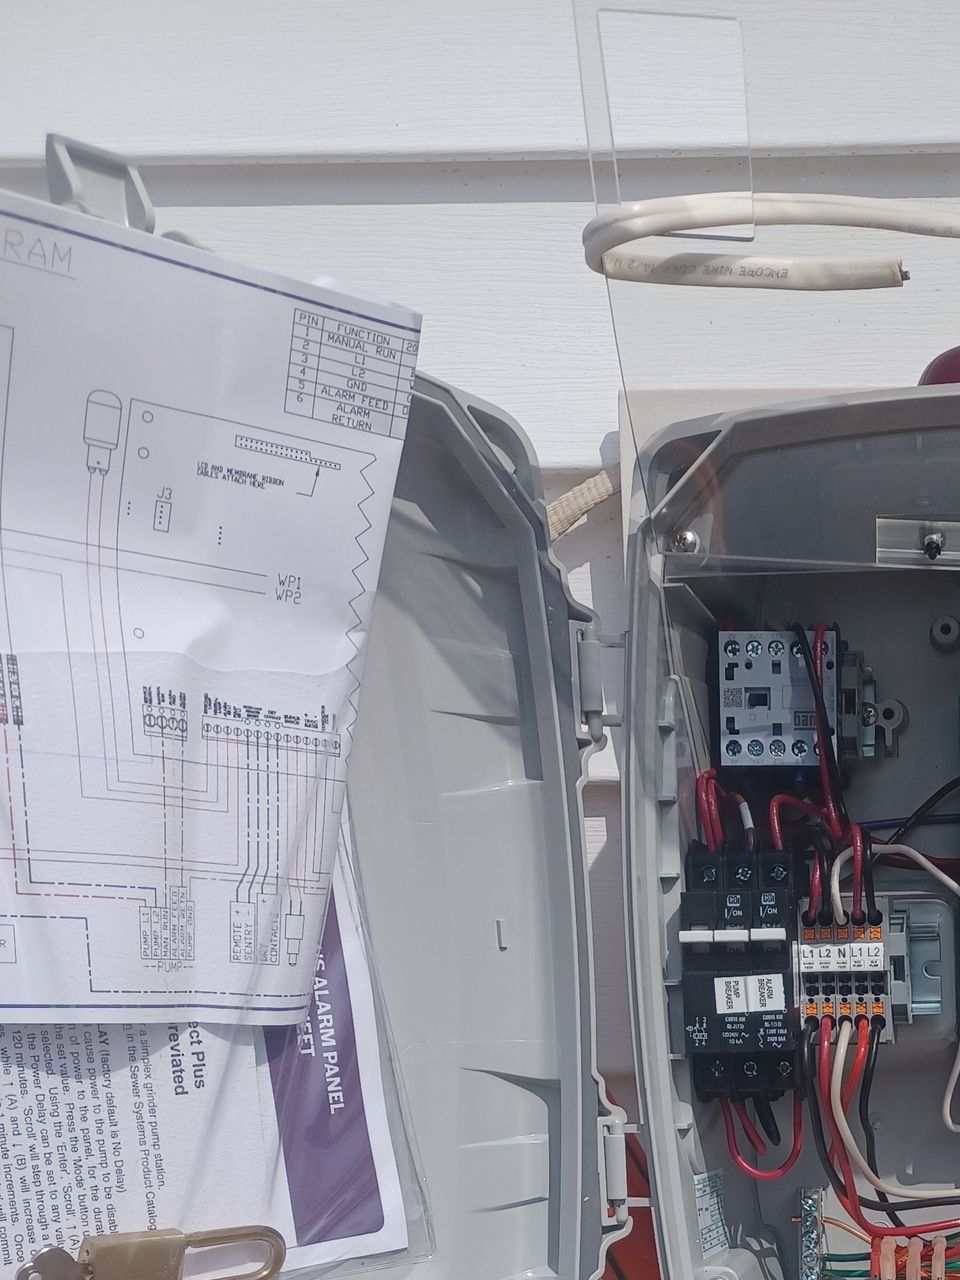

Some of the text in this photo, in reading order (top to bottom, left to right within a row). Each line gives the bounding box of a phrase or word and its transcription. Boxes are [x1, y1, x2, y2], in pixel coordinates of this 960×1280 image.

[299, 312, 391, 346] PIN FUNCTION
[302, 340, 366, 366] 2 L1
[327, 333, 368, 353] MANUAL
[375, 347, 397, 360] RUN
[300, 367, 368, 392] 4 GND
[301, 353, 366, 379] 3 L2
[296, 393, 370, 419] 6 ALARM
[298, 380, 305, 390] 5
[321, 386, 355, 402] ALARM
[361, 395, 389, 411] FEED
[331, 413, 372, 431] RETURN
[156, 487, 173, 500] J3
[222, 474, 247, 486] ATTACH
[275, 587, 302, 605] WP2
[277, 572, 302, 591] WP1
[153, 910, 160, 924] L2
[142, 912, 150, 957] PUMP L1
[233, 922, 242, 960] REMOTE
[244, 923, 253, 961] SENTRY
[803, 946, 880, 958] L1 L2 N L1 L2
[157, 961, 183, 973] PUMP
[725, 981, 734, 1010] BREAKER
[758, 979, 766, 1008] BREAKER
[766, 978, 774, 1000] ALARM
[314, 977, 337, 1047] ALARM
[12, 1031, 23, 1049] 120
[27, 1033, 37, 1050] the
[41, 1030, 56, 1078] selected.
[57, 1043, 67, 1060] set
[70, 1035, 80, 1045] of
[83, 1031, 95, 1064] cause
[127, 1045, 137, 1062] the
[30, 1055, 42, 1089] Power
[70, 1052, 83, 1084] power
[99, 1049, 112, 1089] (factory
[140, 1039, 152, 1079] simplex
[168, 1024, 189, 1096] reviated
[192, 1051, 206, 1089] Plus
[15, 1053, 28, 1098] minutes.
[60, 1063, 71, 1095] value.
[86, 1068, 99, 1100] power
[130, 1065, 141, 1098] Sewer
[323, 1051, 345, 1115] PANEL
[35, 1094, 47, 1124] Delay
[48, 1087, 60, 1117] Using
[77, 1090, 86, 1100] to
[92, 1104, 101, 1114] to
[105, 1092, 117, 1127] default
[143, 1083, 158, 1119] grinder
[65, 1103, 76, 1133] Press
[79, 1105, 89, 1123] the
[95, 1119, 105, 1135] the
[132, 1102, 147, 1146] Systems
[40, 1129, 50, 1148] can
[53, 1121, 64, 1138] the
[80, 1128, 95, 1160] panel,
[148, 1121, 160, 1150] pump
[0, 1047, 36, 1244] while (A) and (B) will increase
[29, 1144, 40, 1161] will
[44, 1152, 53, 1165] be
[69, 1136, 79, 1153] the
[96, 1139, 108, 1168] pump
[112, 1141, 122, 1156] No
[32, 1164, 42, 1187] step
[47, 1170, 57, 1186] set
[88, 1165, 96, 1179] for
[102, 1172, 111, 1182] to
[114, 1160, 127, 1193] Delay)
[140, 1149, 153, 1189] Product
[154, 1153, 166, 1189] station.
[0, 1123, 25, 1262] minute increments. Once
[49, 1190, 58, 1200] to
[90, 1185, 99, 1201] the
[104, 1186, 113, 1199] be
[35, 1190, 50, 1230] through
[51, 1204, 61, 1223] any
[77, 1194, 89, 1227] button
[145, 1191, 157, 1230] Catalog
[0, 1226, 13, 1266] commit
